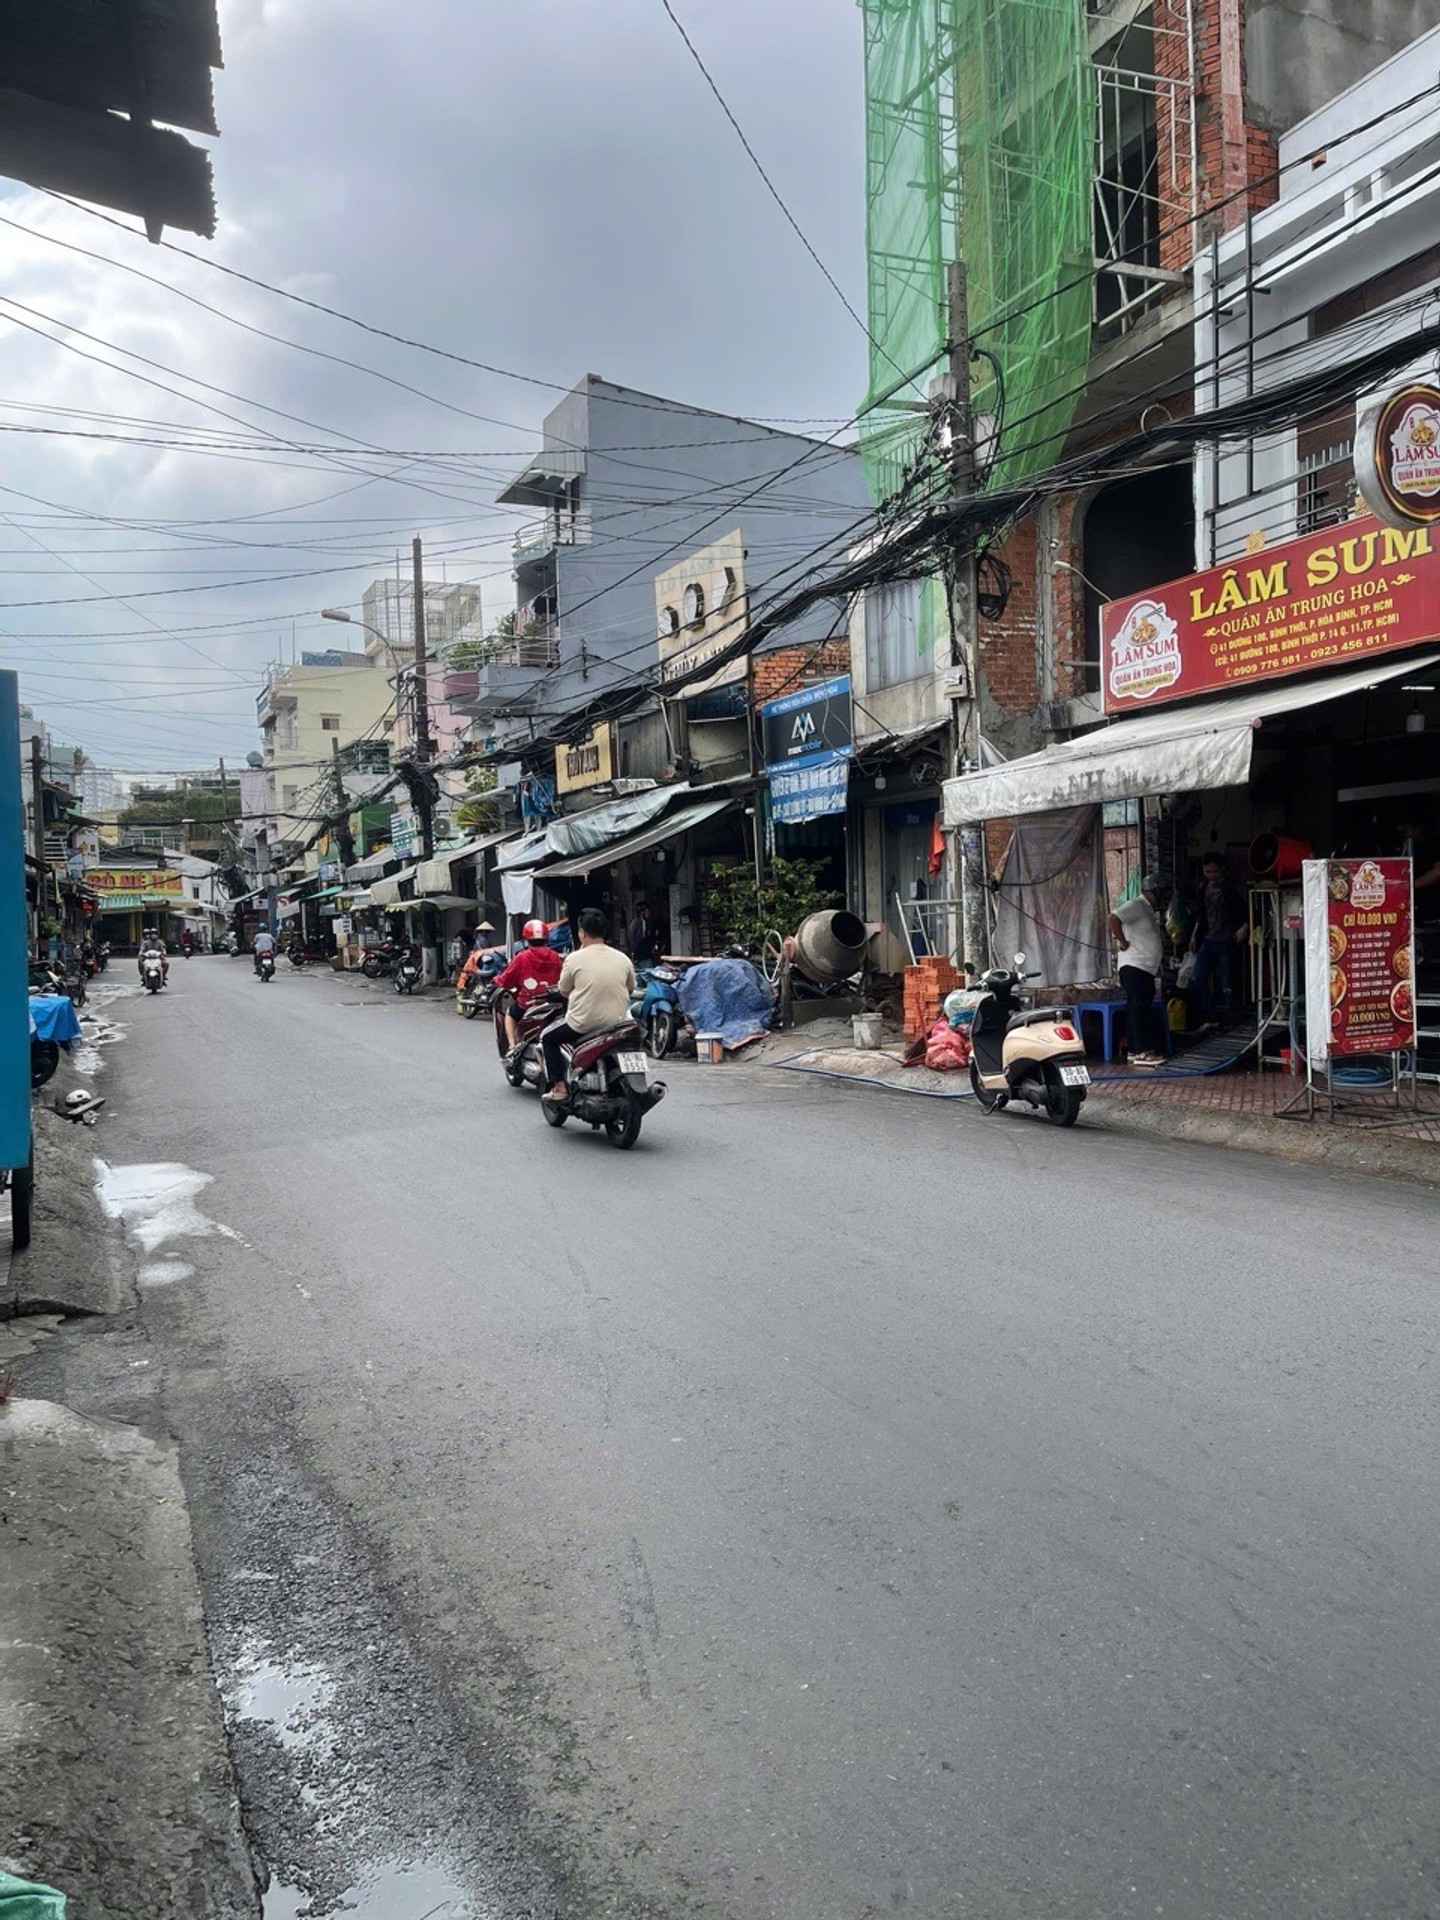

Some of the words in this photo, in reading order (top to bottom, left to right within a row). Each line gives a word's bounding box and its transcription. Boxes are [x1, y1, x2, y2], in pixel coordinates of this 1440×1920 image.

[1395, 444, 1424, 463] LÂM
[1426, 444, 1440, 459] SU
[1189, 561, 1288, 621] LÂM
[1307, 527, 1432, 587] SUM
[1221, 612, 1260, 637] QUÁN
[1265, 606, 1286, 624] ĂN
[1290, 589, 1345, 617] TRUNG
[1350, 578, 1388, 601] HOA
[1309, 619, 1317, 629] P.
[1360, 604, 1372, 615] TP.
[1373, 598, 1393, 612] HCM
[1320, 631, 1327, 641] P.
[1340, 625, 1349, 636] Q.
[1375, 613, 1399, 627] HCM)
[1114, 646, 1144, 667] LÂM
[1146, 637, 1175, 658] SUM
[1233, 664, 1258, 677] 0909
[1261, 658, 1279, 670] 776
[1281, 654, 1300, 665] 981
[1310, 645, 1338, 658] 0923
[1341, 638, 1363, 651] 456
[1366, 632, 1388, 646] 811
